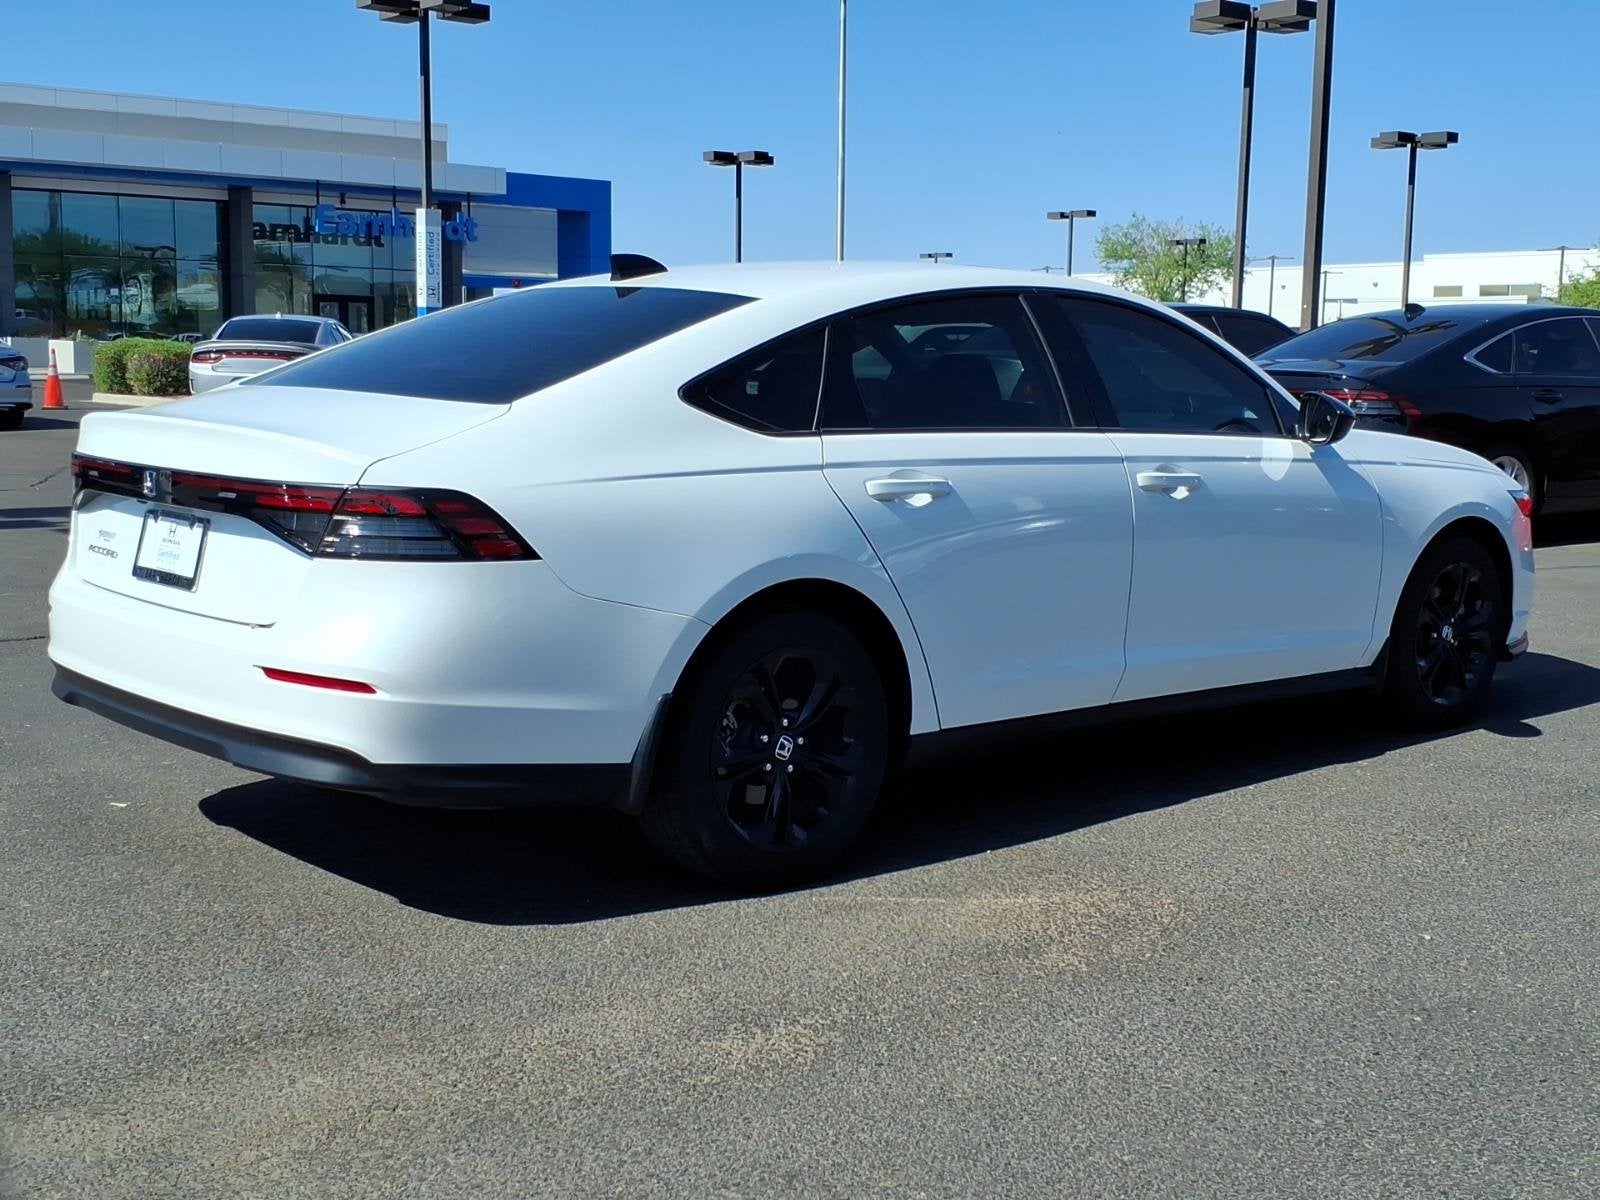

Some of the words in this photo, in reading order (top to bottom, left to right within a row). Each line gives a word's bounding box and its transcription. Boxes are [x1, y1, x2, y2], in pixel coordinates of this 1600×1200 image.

[315, 204, 478, 242] Earnhdt
[427, 231, 436, 275] Certified
[88, 544, 119, 559] ACCORD
